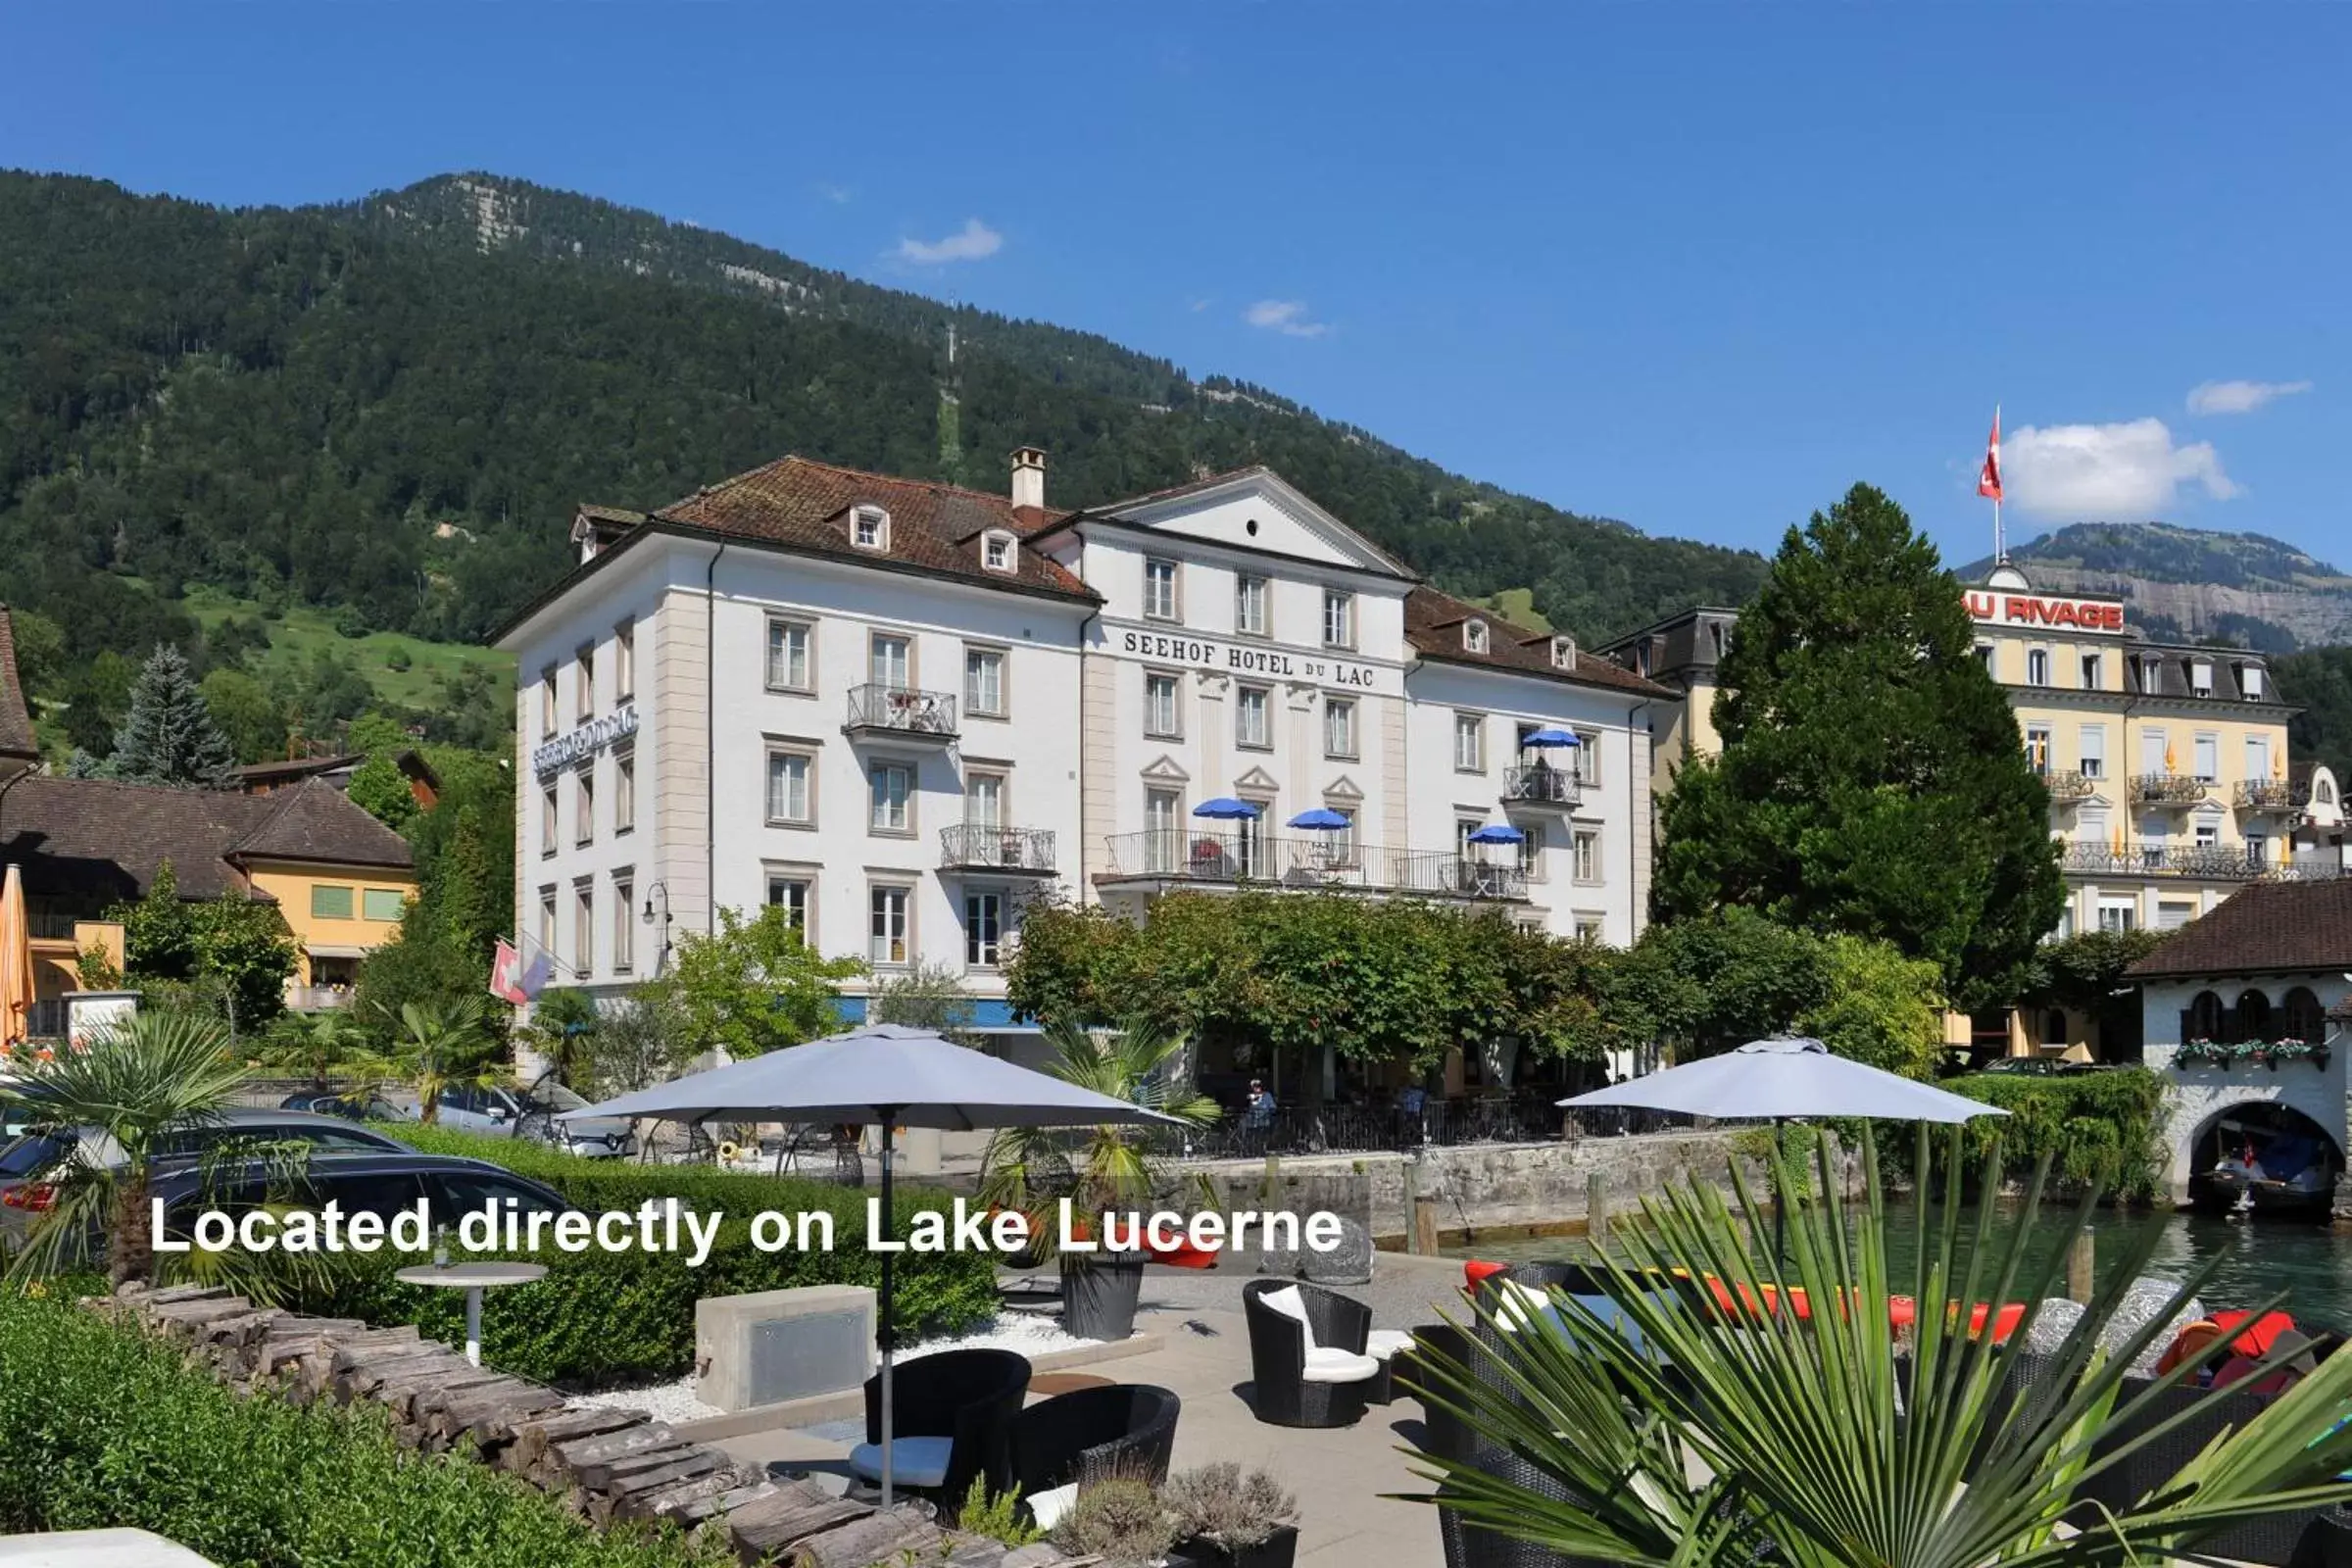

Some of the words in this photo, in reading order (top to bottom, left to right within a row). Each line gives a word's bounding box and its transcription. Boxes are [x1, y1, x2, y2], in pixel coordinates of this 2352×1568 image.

[2004, 597, 2124, 630] RIVAGE
[1125, 632, 1215, 664] SEEHOF
[1228, 648, 1294, 676] HOTEL
[1305, 662, 1325, 677] DU
[1336, 664, 1374, 687] LAC
